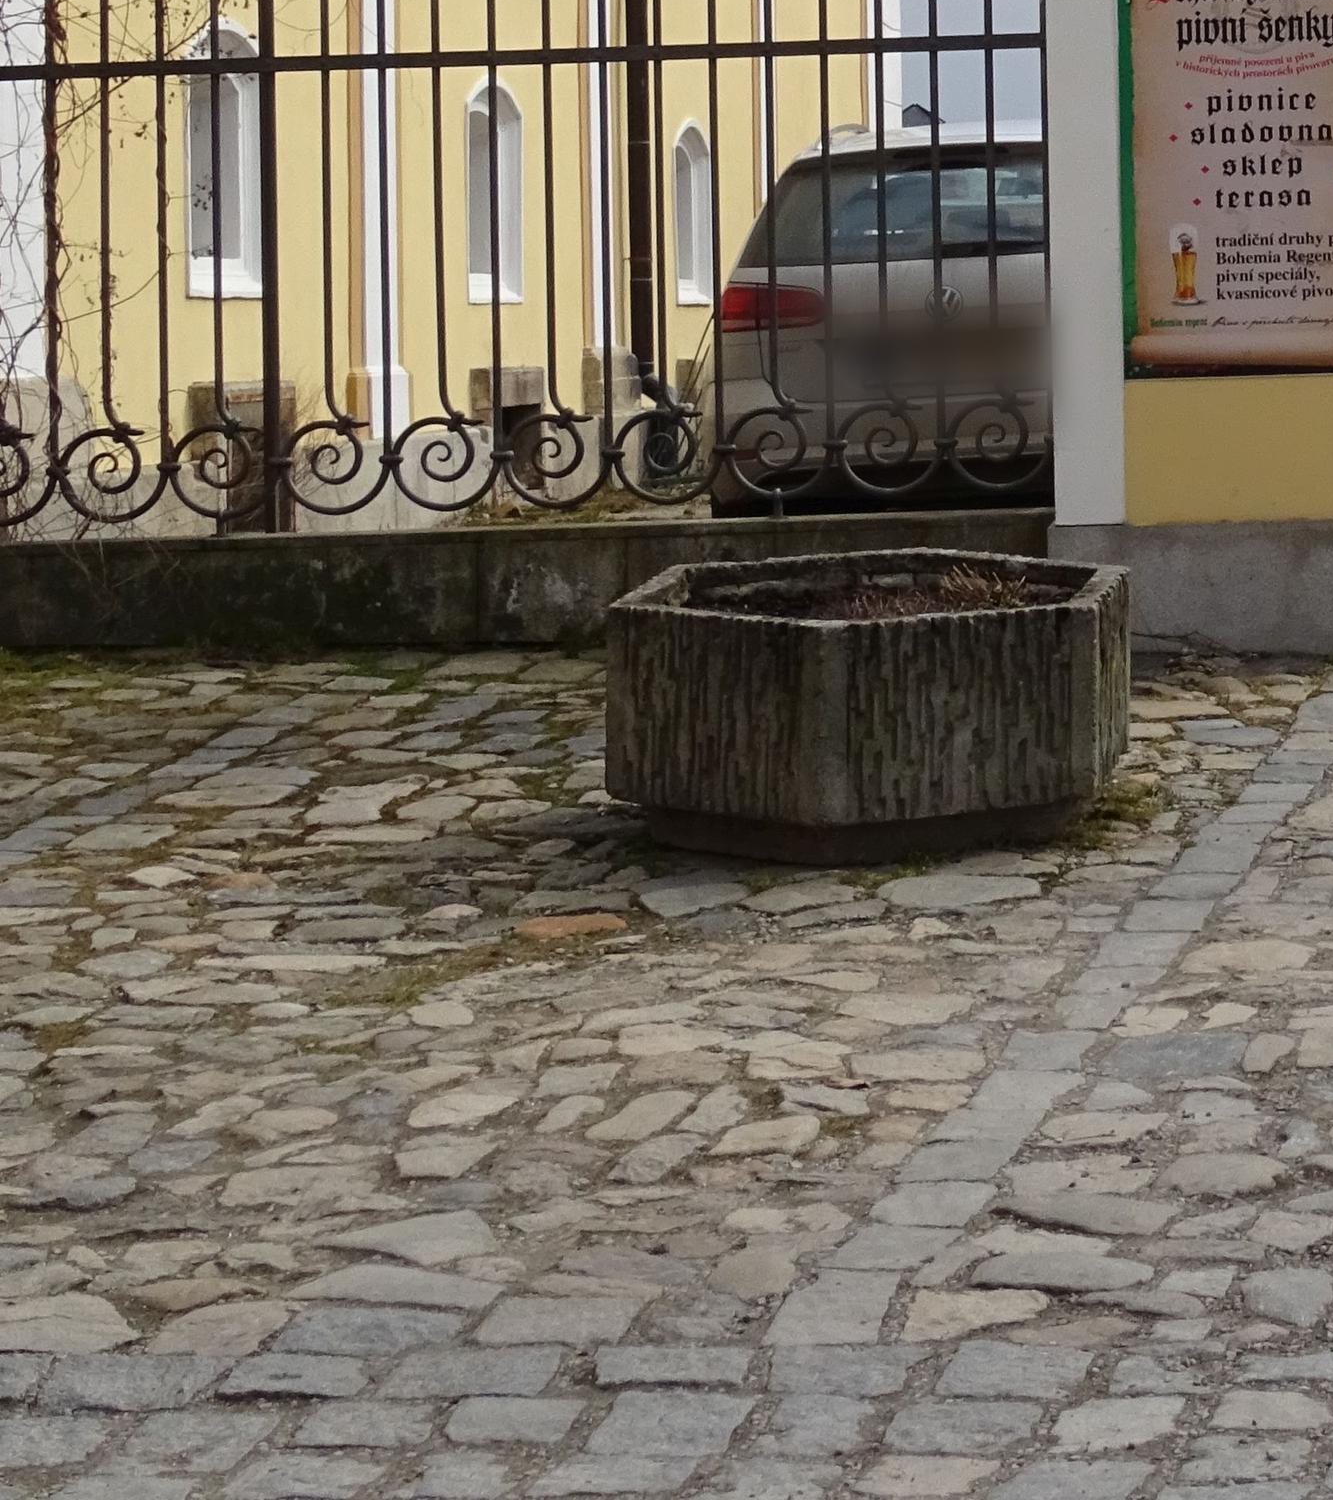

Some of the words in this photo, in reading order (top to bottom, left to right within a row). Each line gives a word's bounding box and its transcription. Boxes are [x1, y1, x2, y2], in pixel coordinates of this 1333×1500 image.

[1175, 8, 1247, 51] pivní
[1206, 87, 1317, 116] pivnice
[1190, 121, 1333, 145] sladovna
[1222, 154, 1304, 178] sklep
[1215, 188, 1313, 209] terasa
[1215, 232, 1275, 248] tradiční
[1278, 231, 1325, 250] druhy
[1215, 250, 1282, 265] Bohemia
[1215, 268, 1255, 286] pivní
[1257, 266, 1322, 285] speciály,
[1215, 285, 1299, 301] kvasnicové
